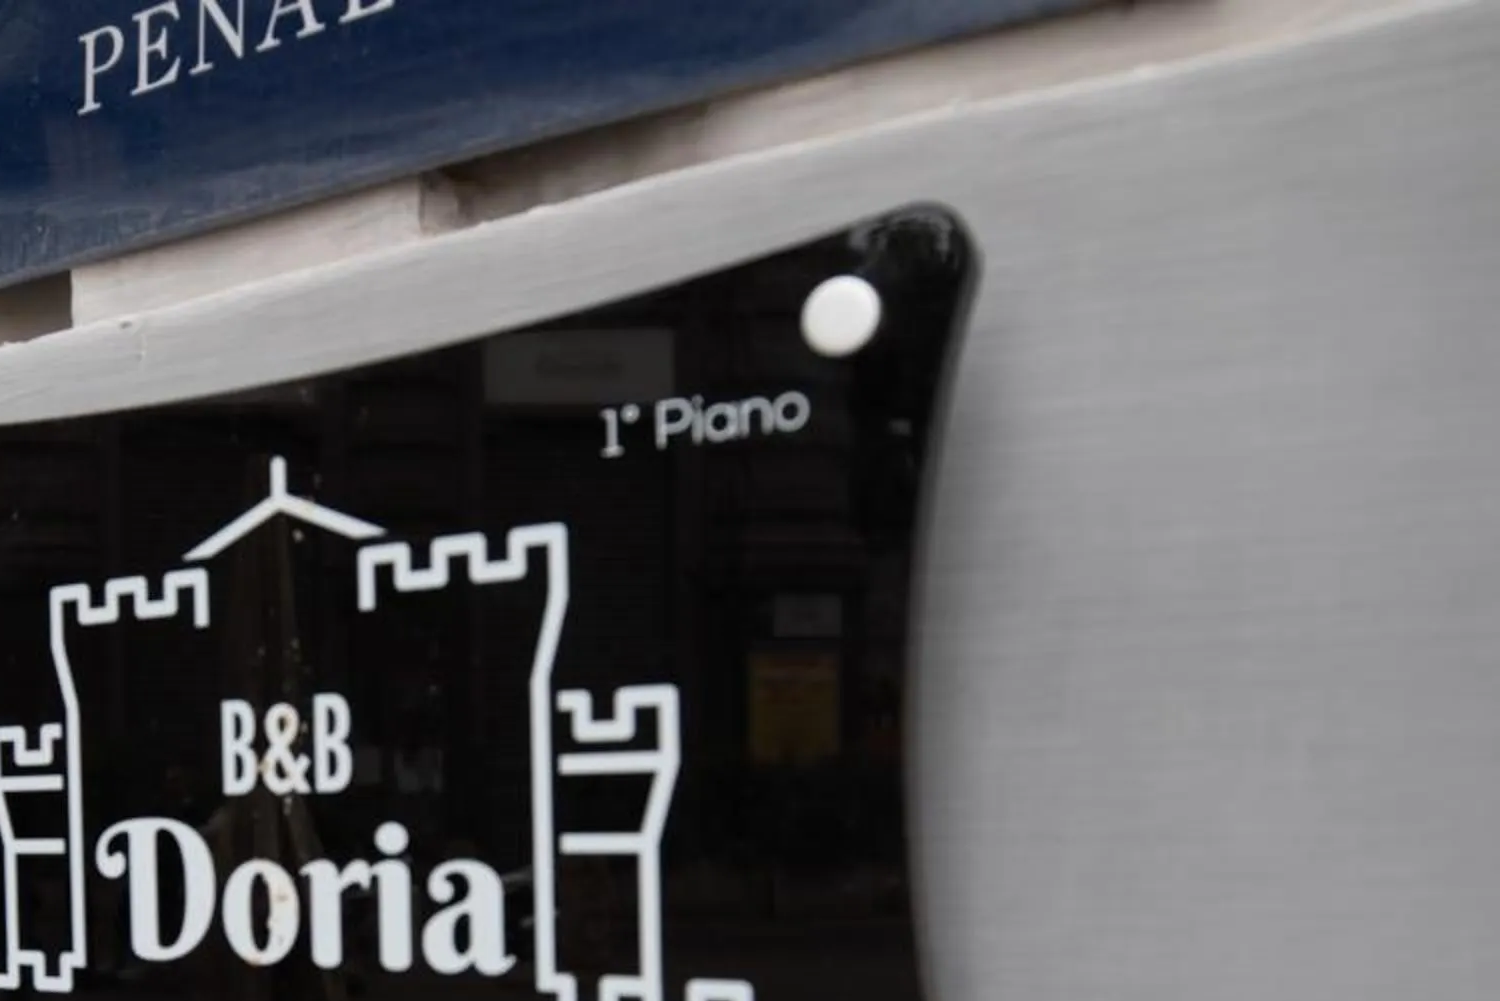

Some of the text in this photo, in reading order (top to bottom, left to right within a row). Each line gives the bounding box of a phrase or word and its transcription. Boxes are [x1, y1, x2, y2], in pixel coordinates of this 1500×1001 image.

[77, 0, 394, 116] PENA
[654, 390, 811, 450] Piano
[220, 691, 353, 797] B&B
[95, 817, 517, 977] Doria
